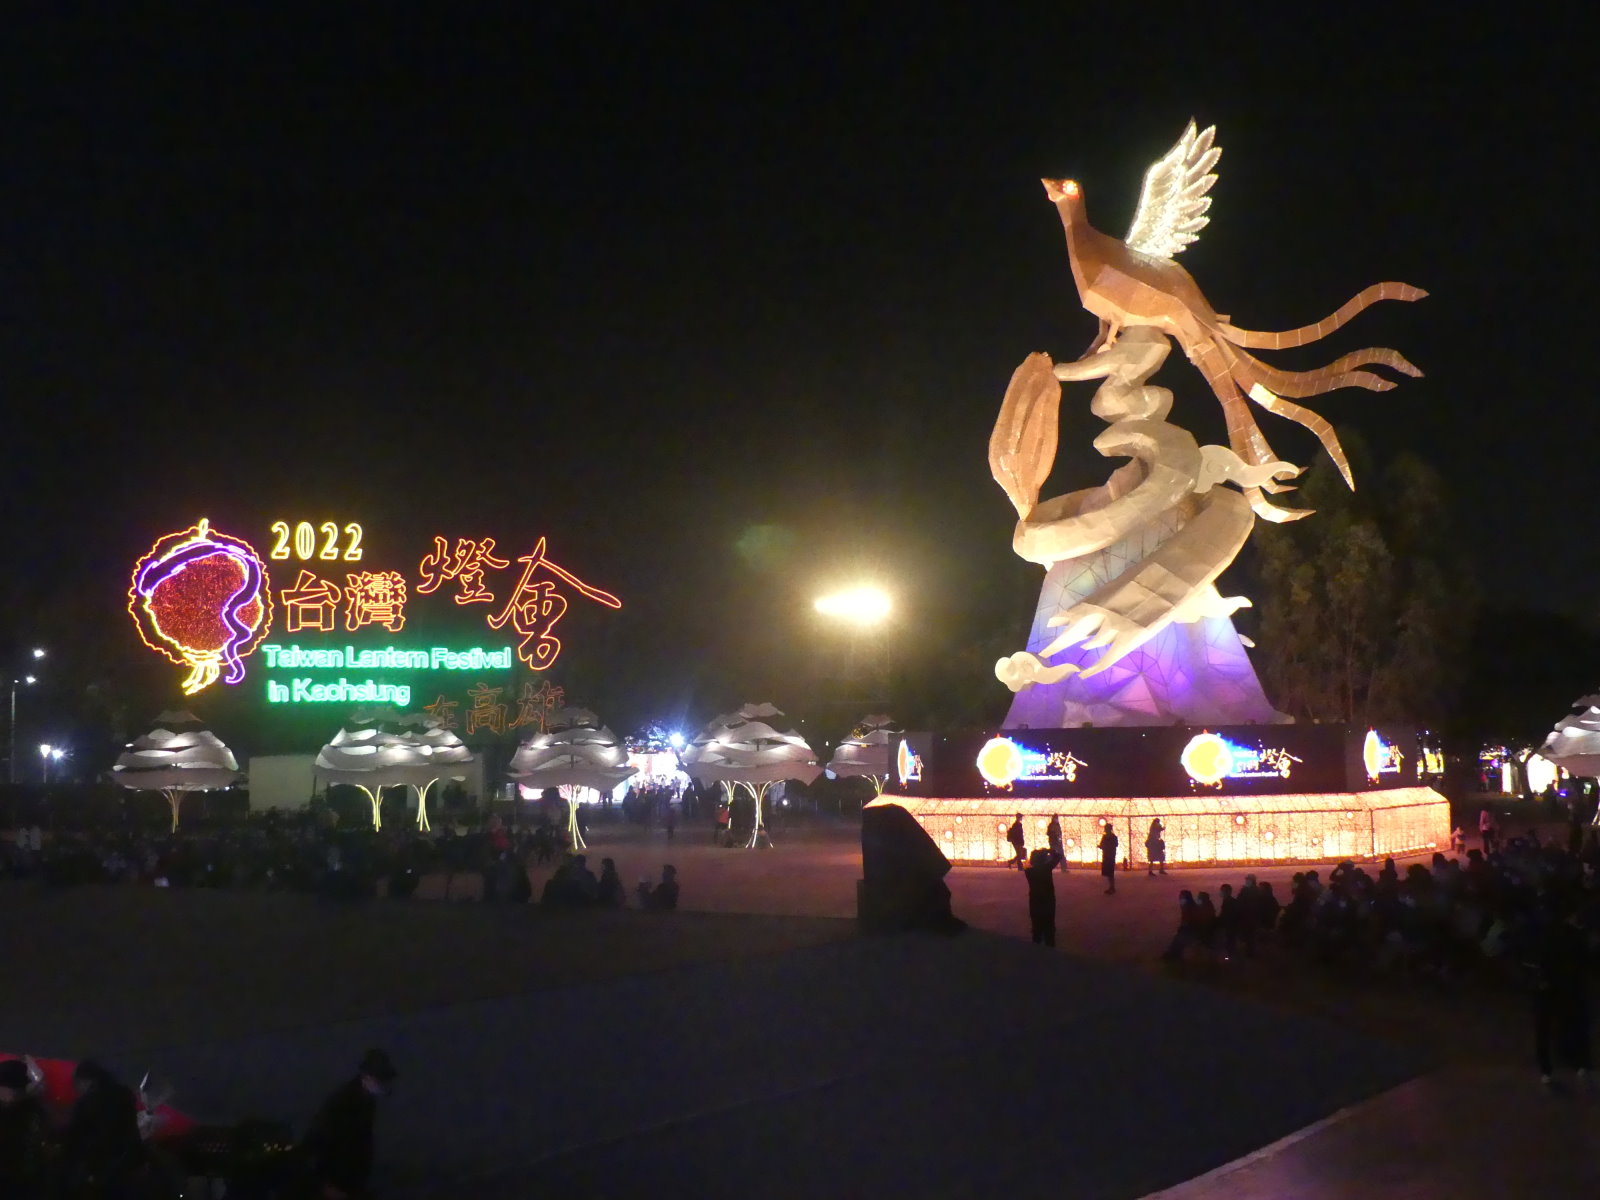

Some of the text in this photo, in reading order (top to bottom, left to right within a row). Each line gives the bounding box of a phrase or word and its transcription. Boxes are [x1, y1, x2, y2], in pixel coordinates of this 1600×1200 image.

[270, 521, 363, 561] 2022
[280, 569, 407, 632] 台灣
[262, 644, 512, 670] Taiwan Lantern Festival
[292, 677, 411, 706] Kaohsiung
